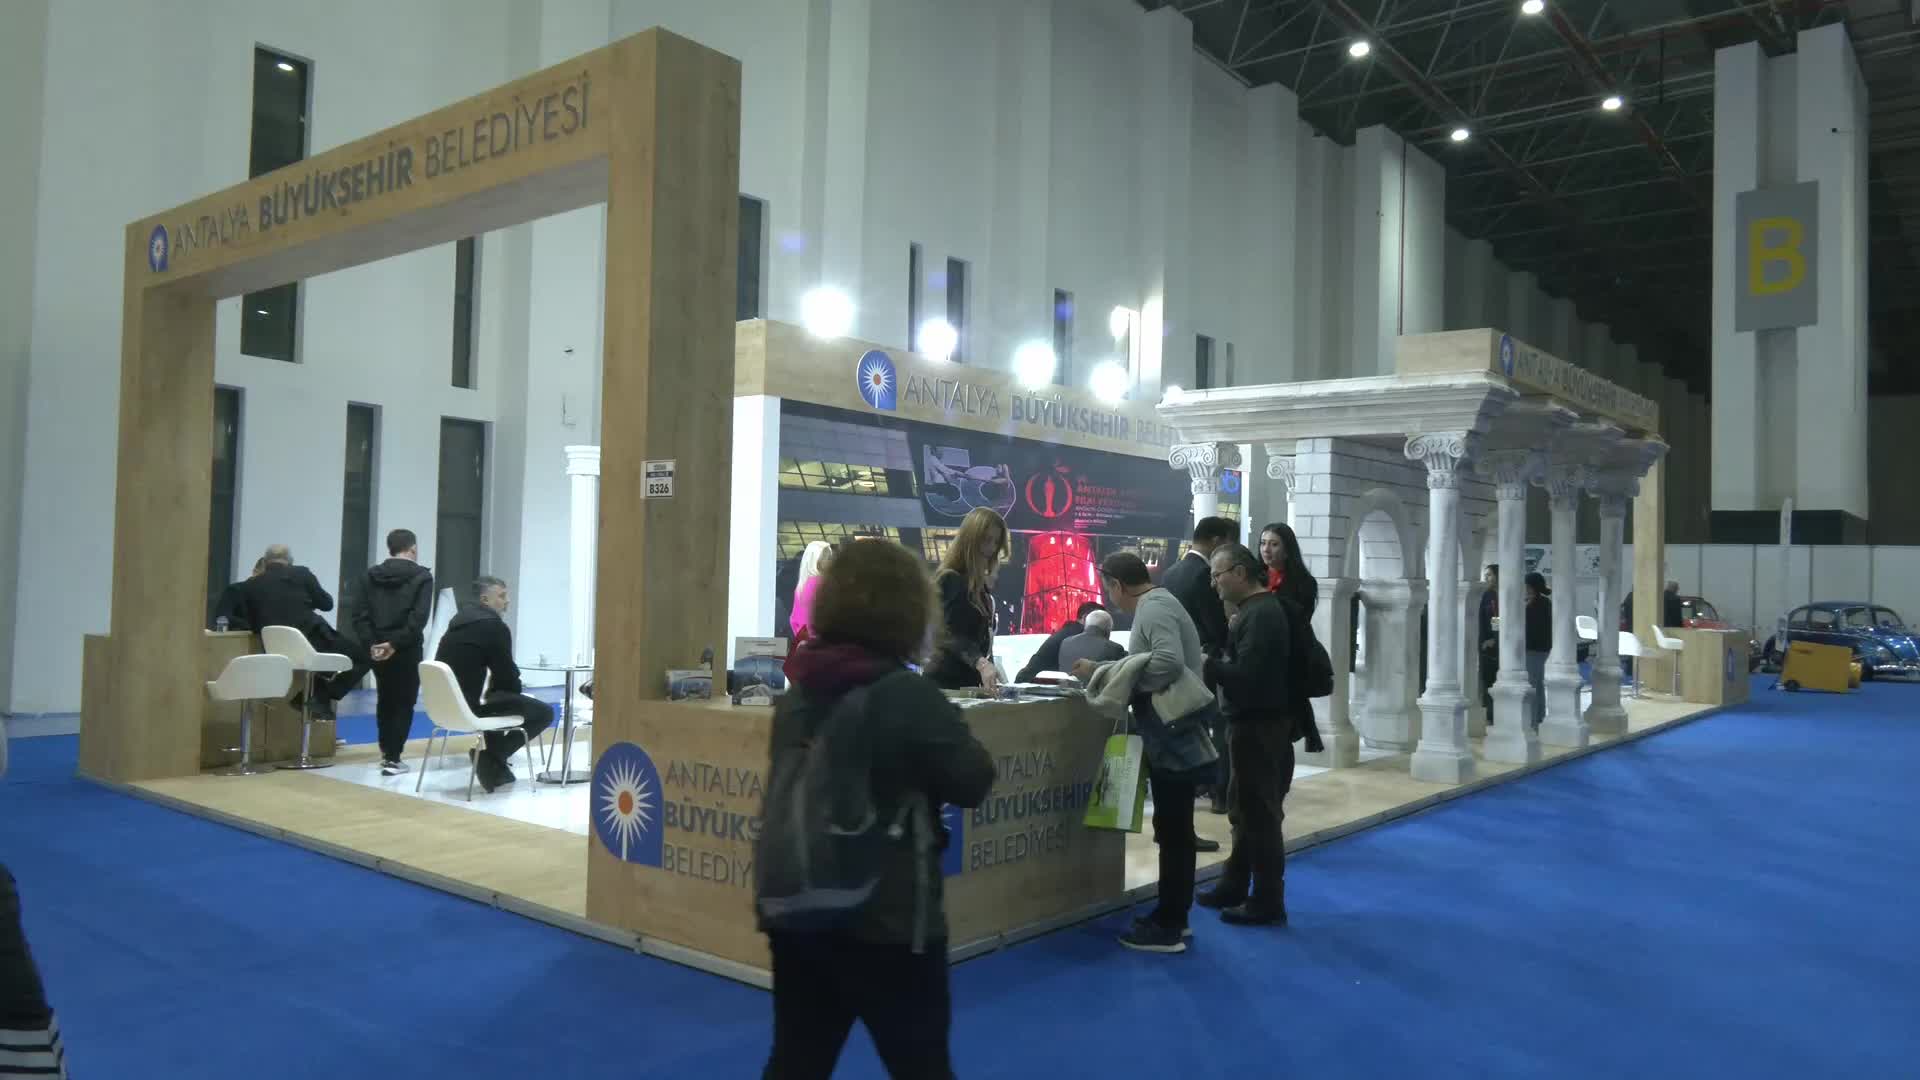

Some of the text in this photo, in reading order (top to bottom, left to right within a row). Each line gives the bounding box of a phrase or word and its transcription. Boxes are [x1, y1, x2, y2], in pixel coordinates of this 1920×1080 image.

[173, 70, 591, 259] ANTALYA BÜYÜKŞEHİR BELEDİYESİ
[1750, 216, 1806, 295] B
[903, 374, 1001, 418] ANTALYA
[1010, 390, 1129, 441] BÜYÜKŞEHİR
[665, 759, 764, 799] ANTALYA
